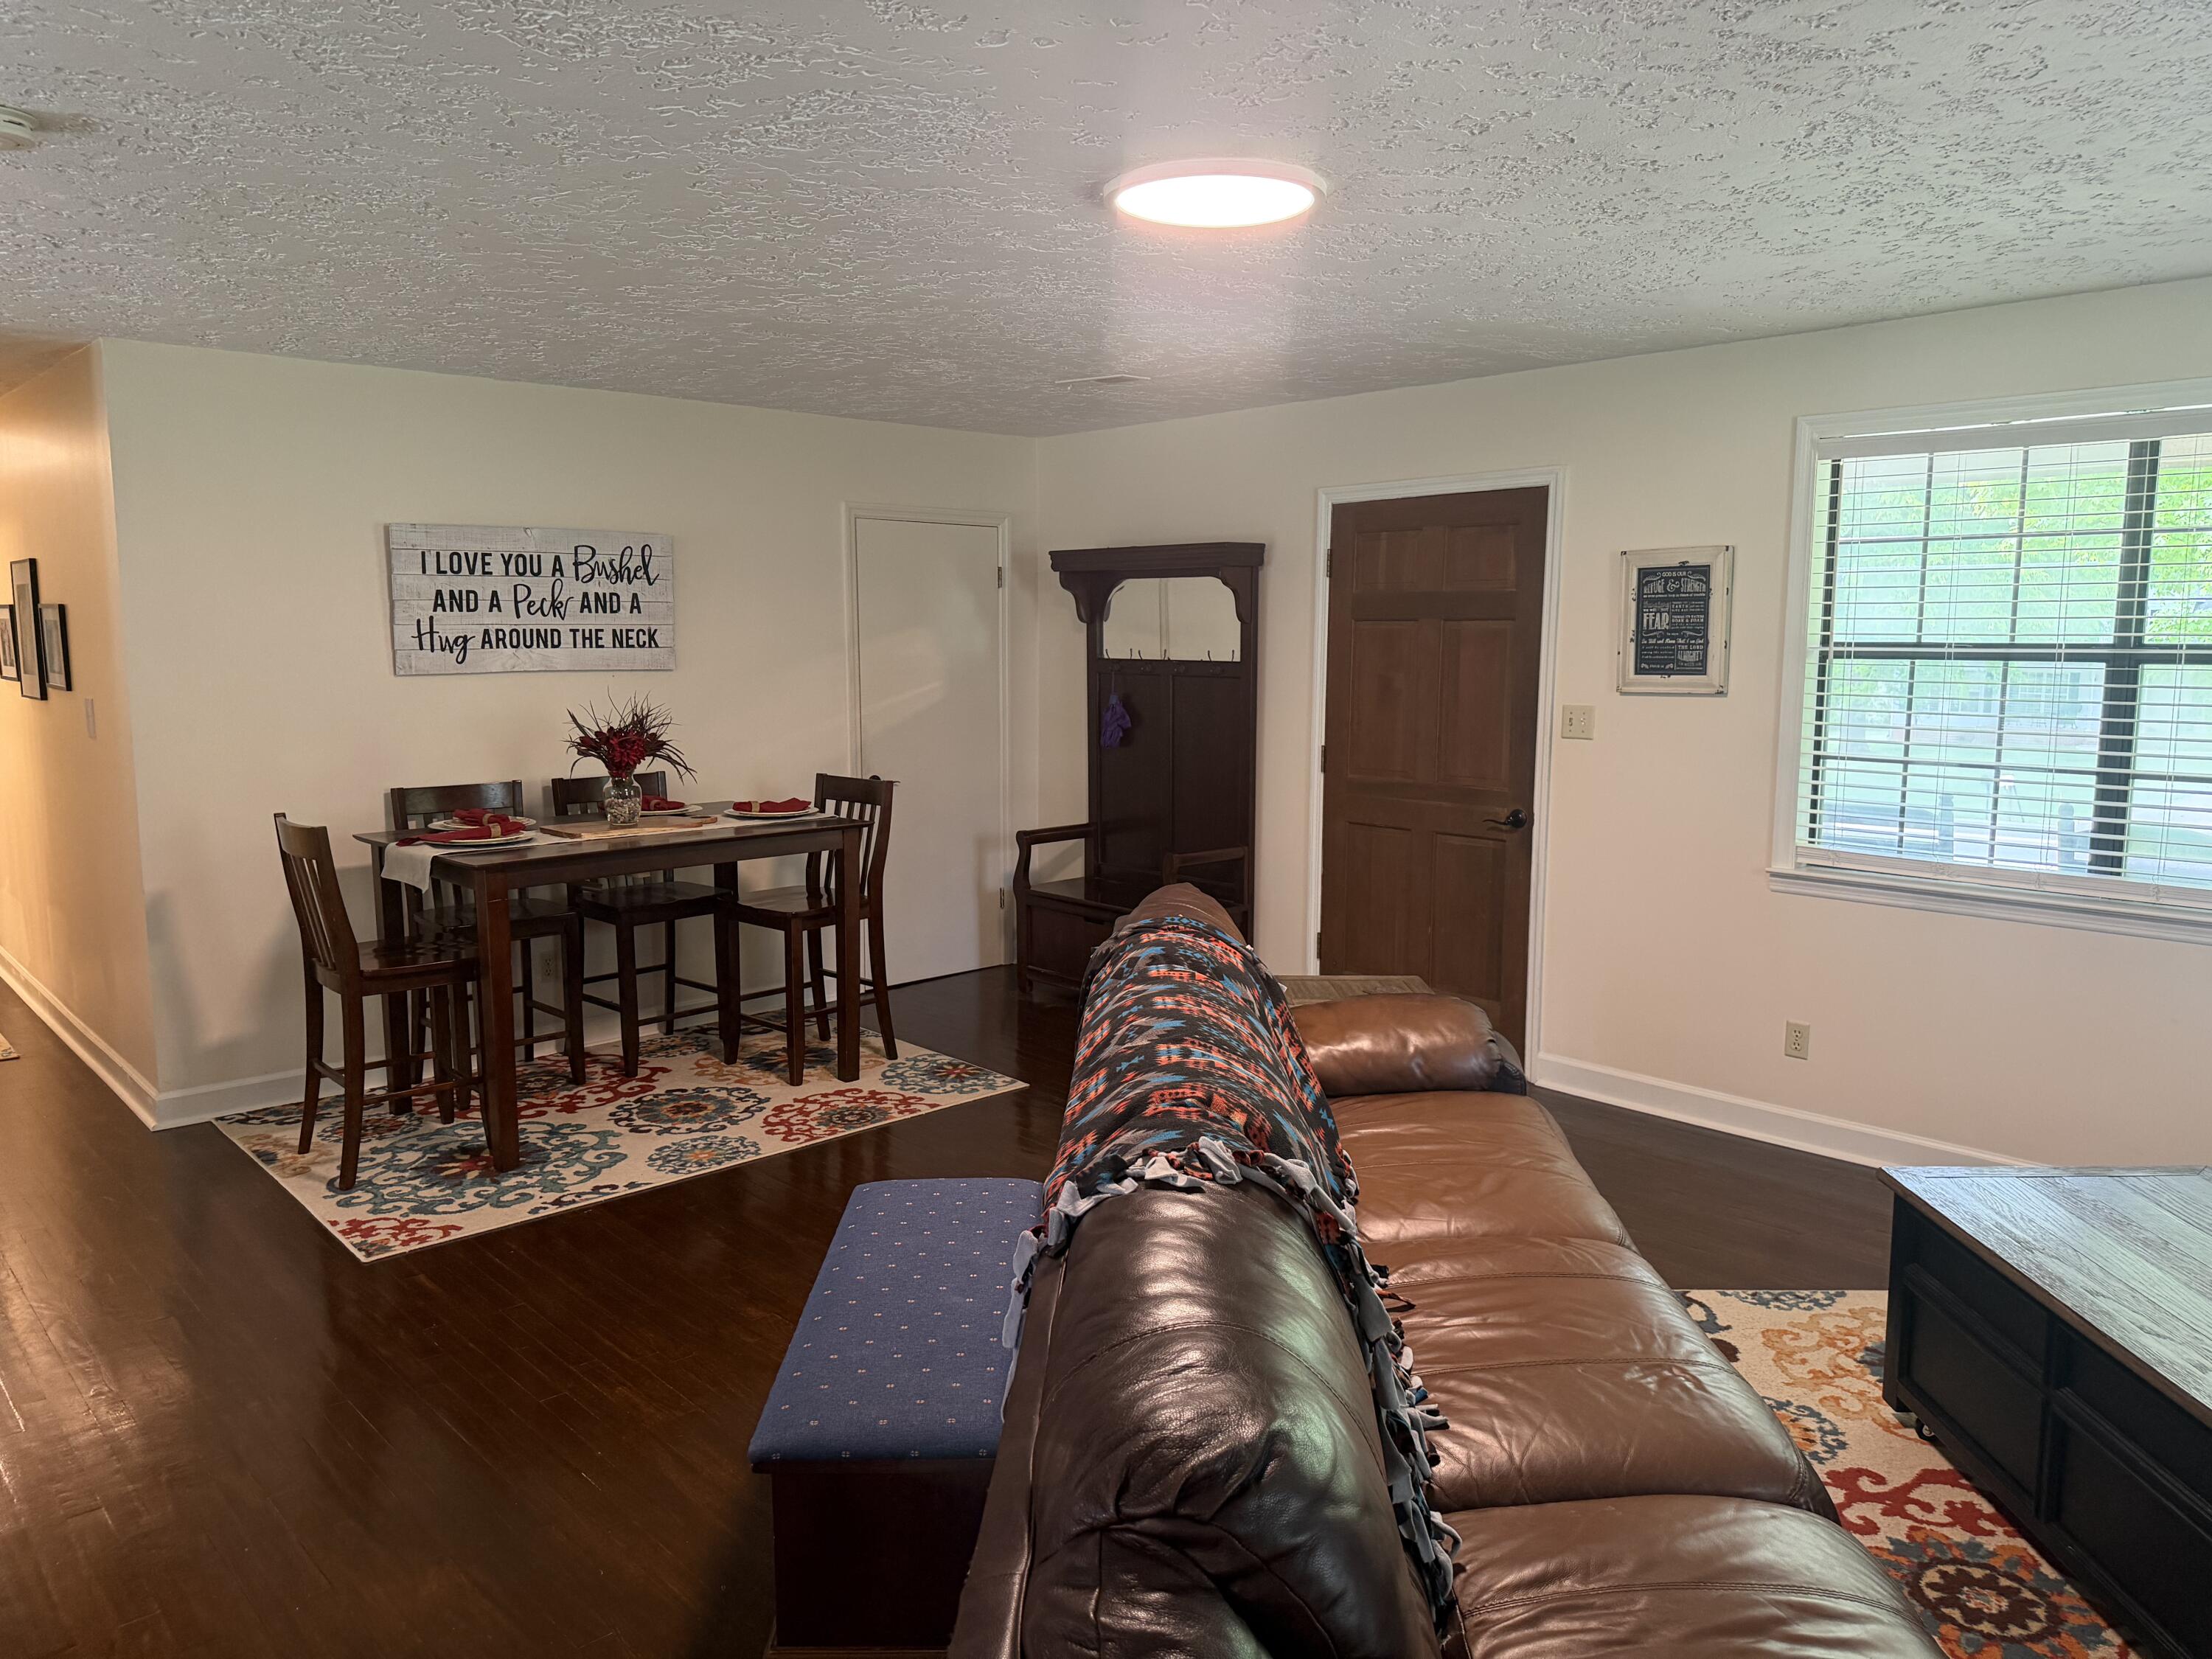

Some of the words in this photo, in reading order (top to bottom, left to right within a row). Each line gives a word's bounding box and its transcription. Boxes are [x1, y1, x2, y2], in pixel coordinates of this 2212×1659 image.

[421, 550, 426, 574] I
[436, 551, 493, 575] LOVE
[501, 553, 542, 577] YOU
[552, 554, 565, 577] A
[572, 543, 660, 586] Bushel
[1644, 579, 1665, 594] REFUGE
[1666, 578, 1680, 592] &
[1680, 577, 1706, 593] STRENGTH
[432, 589, 479, 613] AND
[489, 590, 502, 613] A
[513, 578, 574, 621] Peck
[580, 591, 621, 614] AND
[629, 593, 642, 614] A
[1643, 612, 1669, 630] FEAR
[411, 615, 476, 664] Hug
[481, 627, 562, 650] AROUND
[569, 627, 603, 649] THE
[612, 627, 659, 649] NECK
